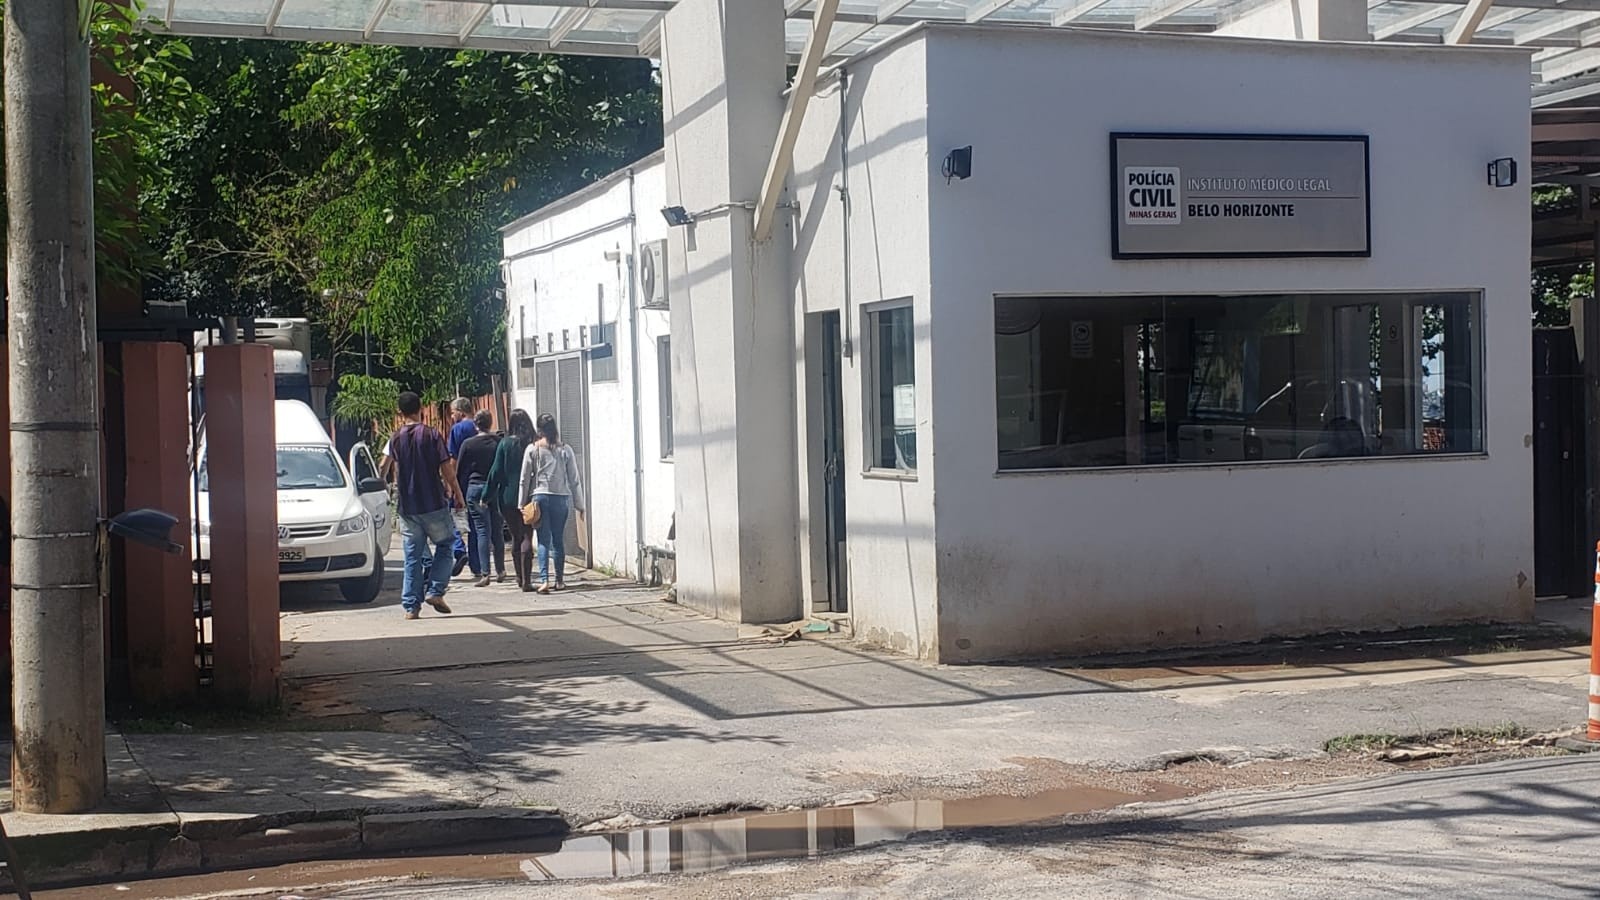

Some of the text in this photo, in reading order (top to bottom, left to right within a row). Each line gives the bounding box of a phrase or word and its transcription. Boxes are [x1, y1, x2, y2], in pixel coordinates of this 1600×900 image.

[1128, 170, 1175, 186] POLÍCIA
[1187, 175, 1331, 191] INSTITUTO MÉDICO LEGAL
[1128, 188, 1176, 207] CIVIL
[1129, 210, 1177, 219] MINAS GERAIS
[1188, 204, 1295, 217] BELO HORIZONTE
